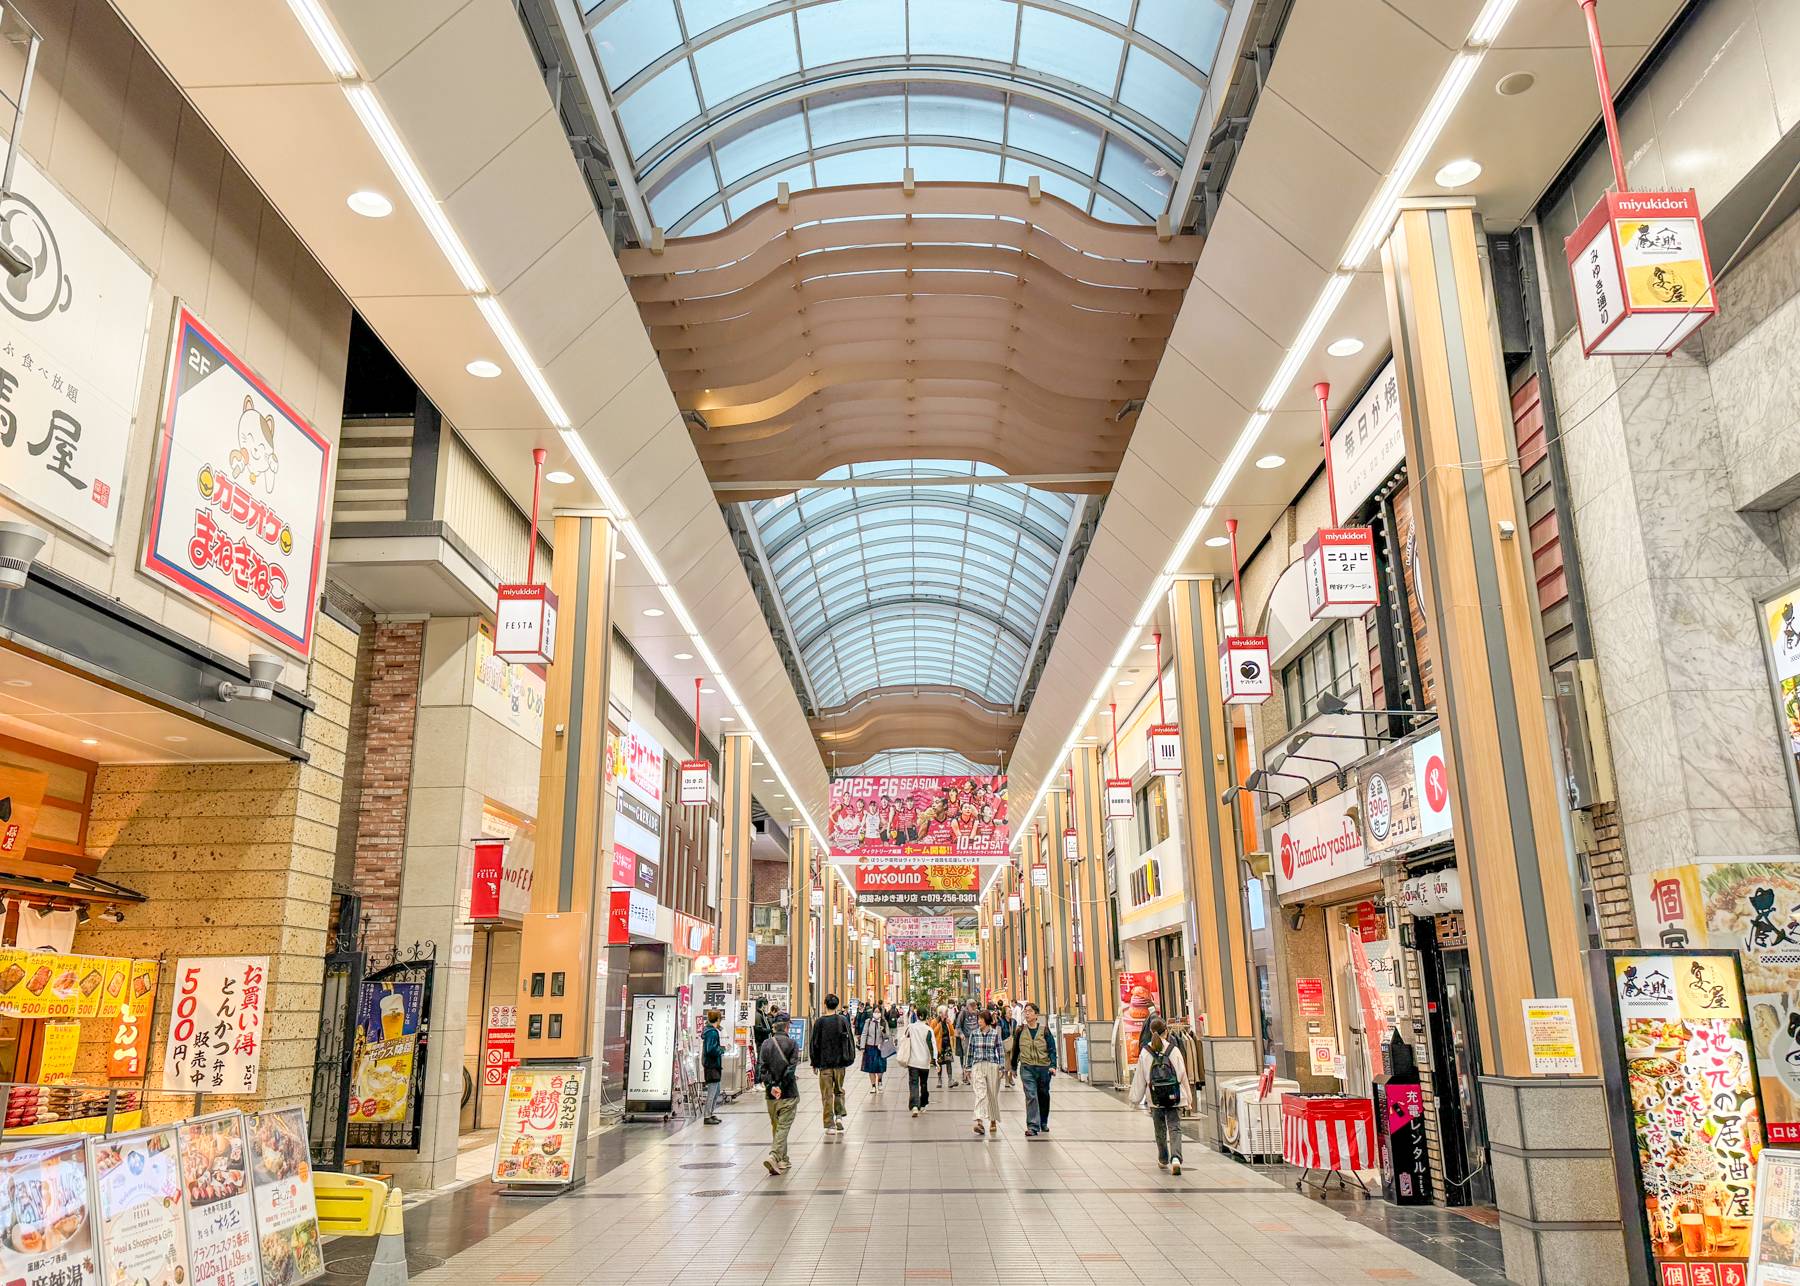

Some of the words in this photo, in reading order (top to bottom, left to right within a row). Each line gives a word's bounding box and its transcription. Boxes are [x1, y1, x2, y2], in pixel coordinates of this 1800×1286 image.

[1619, 198, 1688, 212] miyukidori
[188, 346, 212, 377] 2F
[211, 471, 283, 545] カラオケ
[1324, 532, 1367, 542] miyukidori
[189, 508, 288, 612] まねきねこ
[1342, 563, 1356, 572] 2F
[502, 588, 541, 597] miyukidori
[505, 621, 533, 630] FESTA
[1231, 639, 1264, 647] miyukidori
[832, 778, 899, 798] 2025-26
[900, 778, 939, 791] SEASON
[1401, 786, 1414, 810] 2F
[1368, 797, 1389, 818] 390円
[956, 835, 990, 851] 10.25
[990, 840, 1004, 850] SAT
[476, 871, 498, 879] FESTA
[863, 873, 922, 885] JOYSOUND
[942, 877, 961, 888] OK
[48, 1003, 76, 1015] 600円
[233, 964, 262, 1057] お買い得
[740, 1002, 749, 1021] 最安
[211, 976, 237, 1088] とんかつ弁当
[641, 998, 657, 1083] GRENADE
[190, 1030, 211, 1088] 販売中
[1664, 1079, 1687, 1144] いい酒で
[1696, 1022, 1754, 1218] 地元の居酒屋
[1405, 1090, 1426, 1174] 充電レンタル
[1645, 1095, 1676, 1231] いい夜ができあがる
[132, 1235, 159, 1250] Shopping
